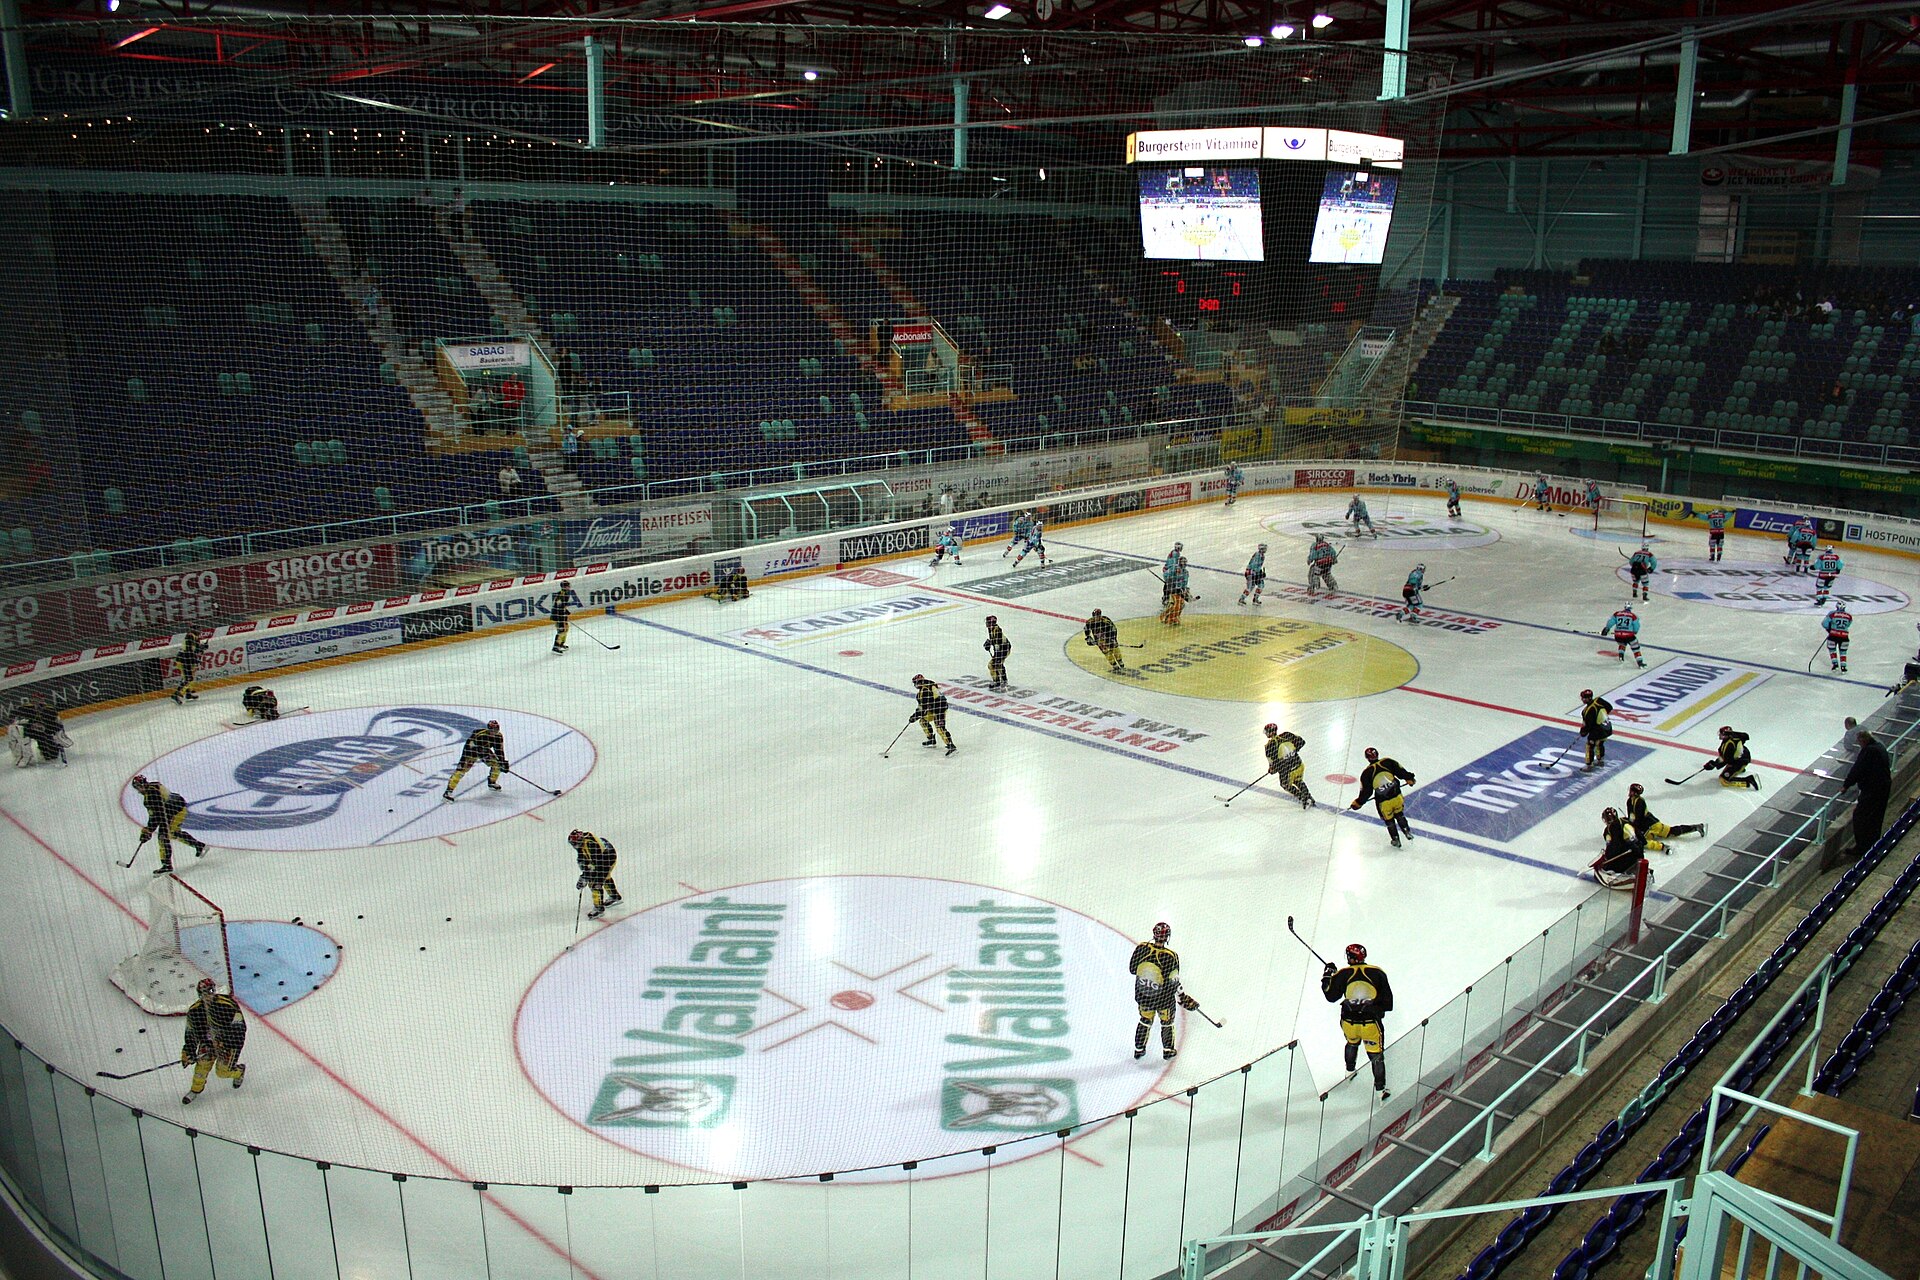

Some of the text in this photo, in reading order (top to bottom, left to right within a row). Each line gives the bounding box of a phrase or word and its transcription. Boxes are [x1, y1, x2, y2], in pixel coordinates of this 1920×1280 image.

[1138, 137, 1259, 156] Burgerstein Vitamine
[1727, 167, 1796, 177] WELCOME TO
[1727, 175, 1833, 185] ICE HOCKEY COUNTR
[893, 331, 932, 342] McDonald's
[470, 346, 505, 357] SABAG
[1306, 469, 1346, 479] SIROCCO
[1308, 478, 1343, 488] KAFFEE
[1058, 497, 1104, 517] TERRA
[1652, 498, 1681, 511] radio
[641, 509, 712, 532] RAIFFEISEN
[962, 521, 1000, 540] bico
[843, 526, 927, 563] NAVYBOOT
[1864, 530, 1920, 548] HOSTPOINT
[266, 547, 375, 583] SIROCCO
[1823, 561, 1836, 570] 80
[95, 570, 219, 609] SIROCCO
[275, 572, 369, 606] KAFFEE
[589, 568, 711, 606] mobilezone
[106, 595, 215, 635] KAFFEE
[475, 589, 584, 628] NOKA
[781, 593, 947, 633] CALANDA
[404, 614, 465, 639] MANOR
[314, 644, 338, 655] Jeep
[360, 634, 394, 645] DODGE
[1614, 661, 1732, 713] CALANDA
[255, 738, 393, 793] AMAG
[611, 895, 788, 1068] Vaillant
[943, 897, 1073, 1072] Vaillant
[1138, 976, 1160, 991] SIG
